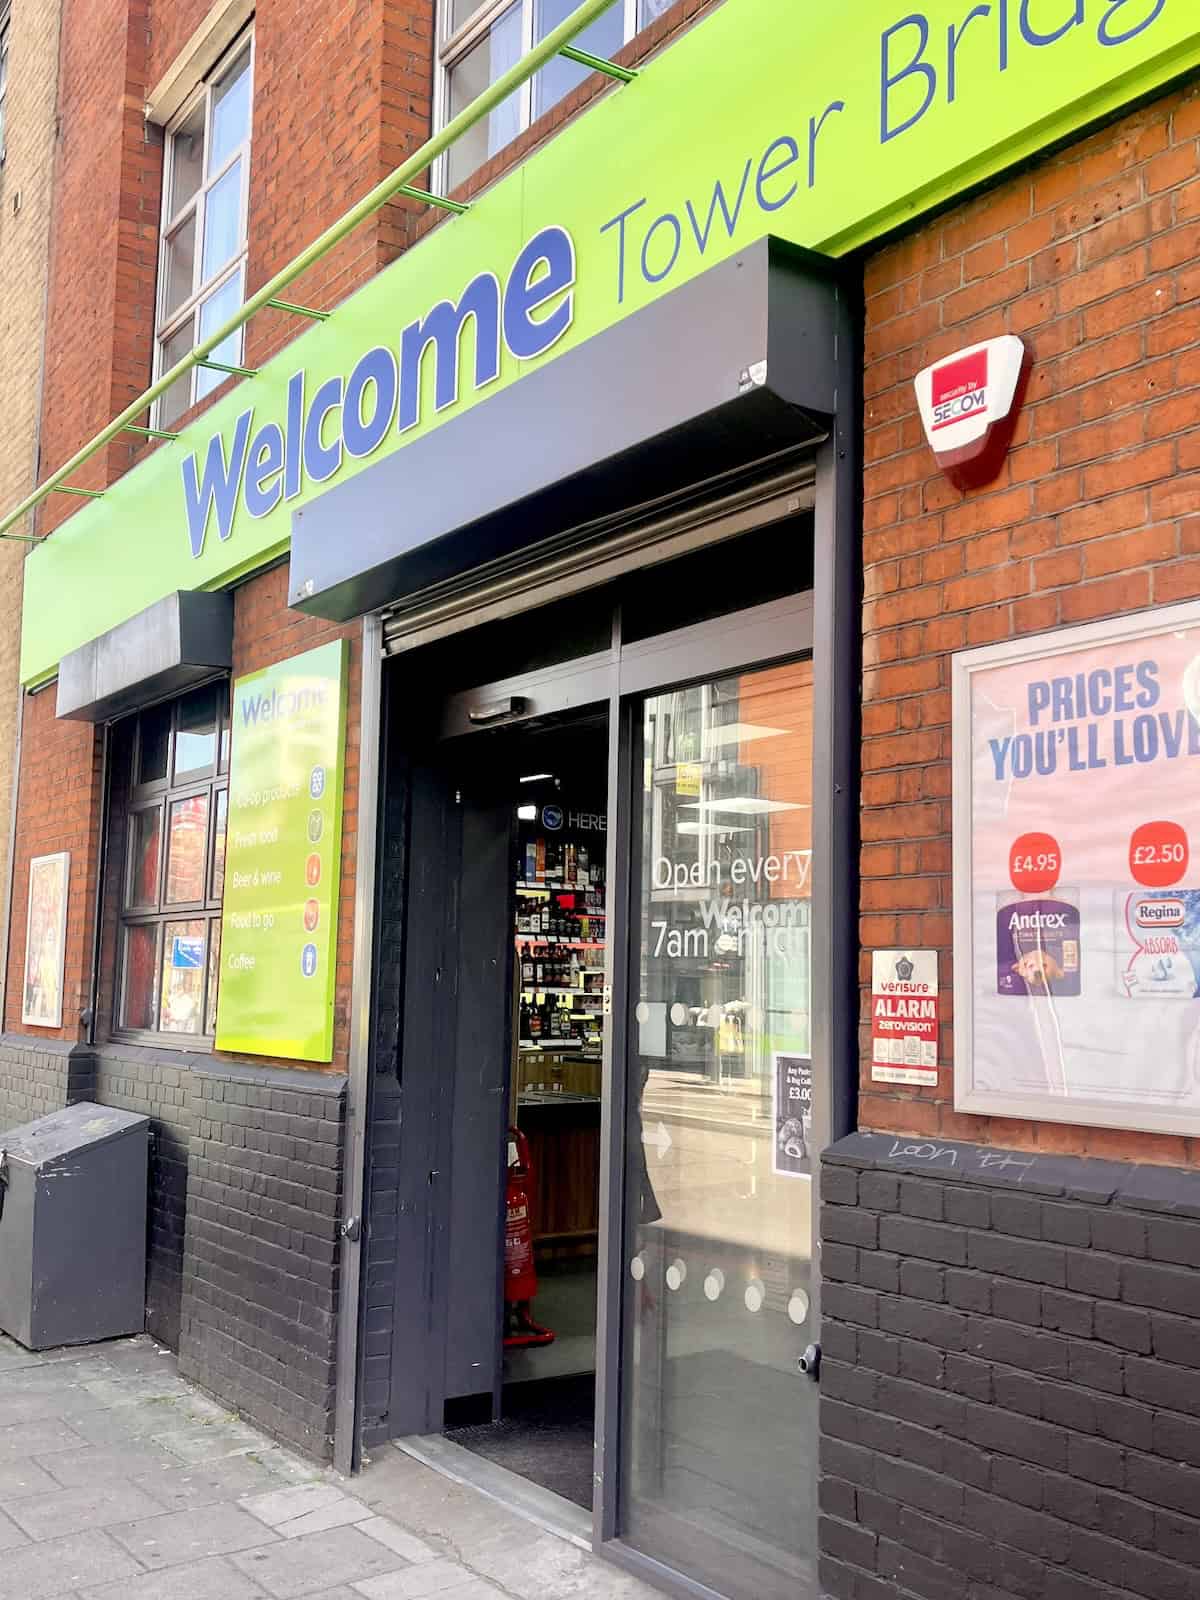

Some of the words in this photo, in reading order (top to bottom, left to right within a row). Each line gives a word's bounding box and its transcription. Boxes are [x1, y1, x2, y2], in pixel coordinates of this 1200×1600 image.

[181, 225, 576, 558] Welcome
[600, 101, 845, 304] Tower
[934, 390, 985, 423] SECOM
[1027, 660, 1161, 726] PRICES
[988, 723, 1107, 781] YOU'LL
[568, 811, 607, 831] HERE
[1013, 853, 1057, 873] £4.95
[1133, 843, 1185, 865] £2.50
[232, 871, 250, 889] Beer
[262, 870, 282, 885] wine
[654, 856, 721, 894] Open
[730, 853, 812, 888] every
[231, 911, 252, 929] Food
[252, 912, 262, 928] to
[263, 914, 274, 931] go
[1008, 911, 1067, 930] Andrex
[1140, 905, 1181, 919] Regina
[651, 920, 709, 959] 7am
[228, 952, 256, 970] Coffee
[880, 982, 929, 993] verisure
[875, 998, 936, 1020] ALARM
